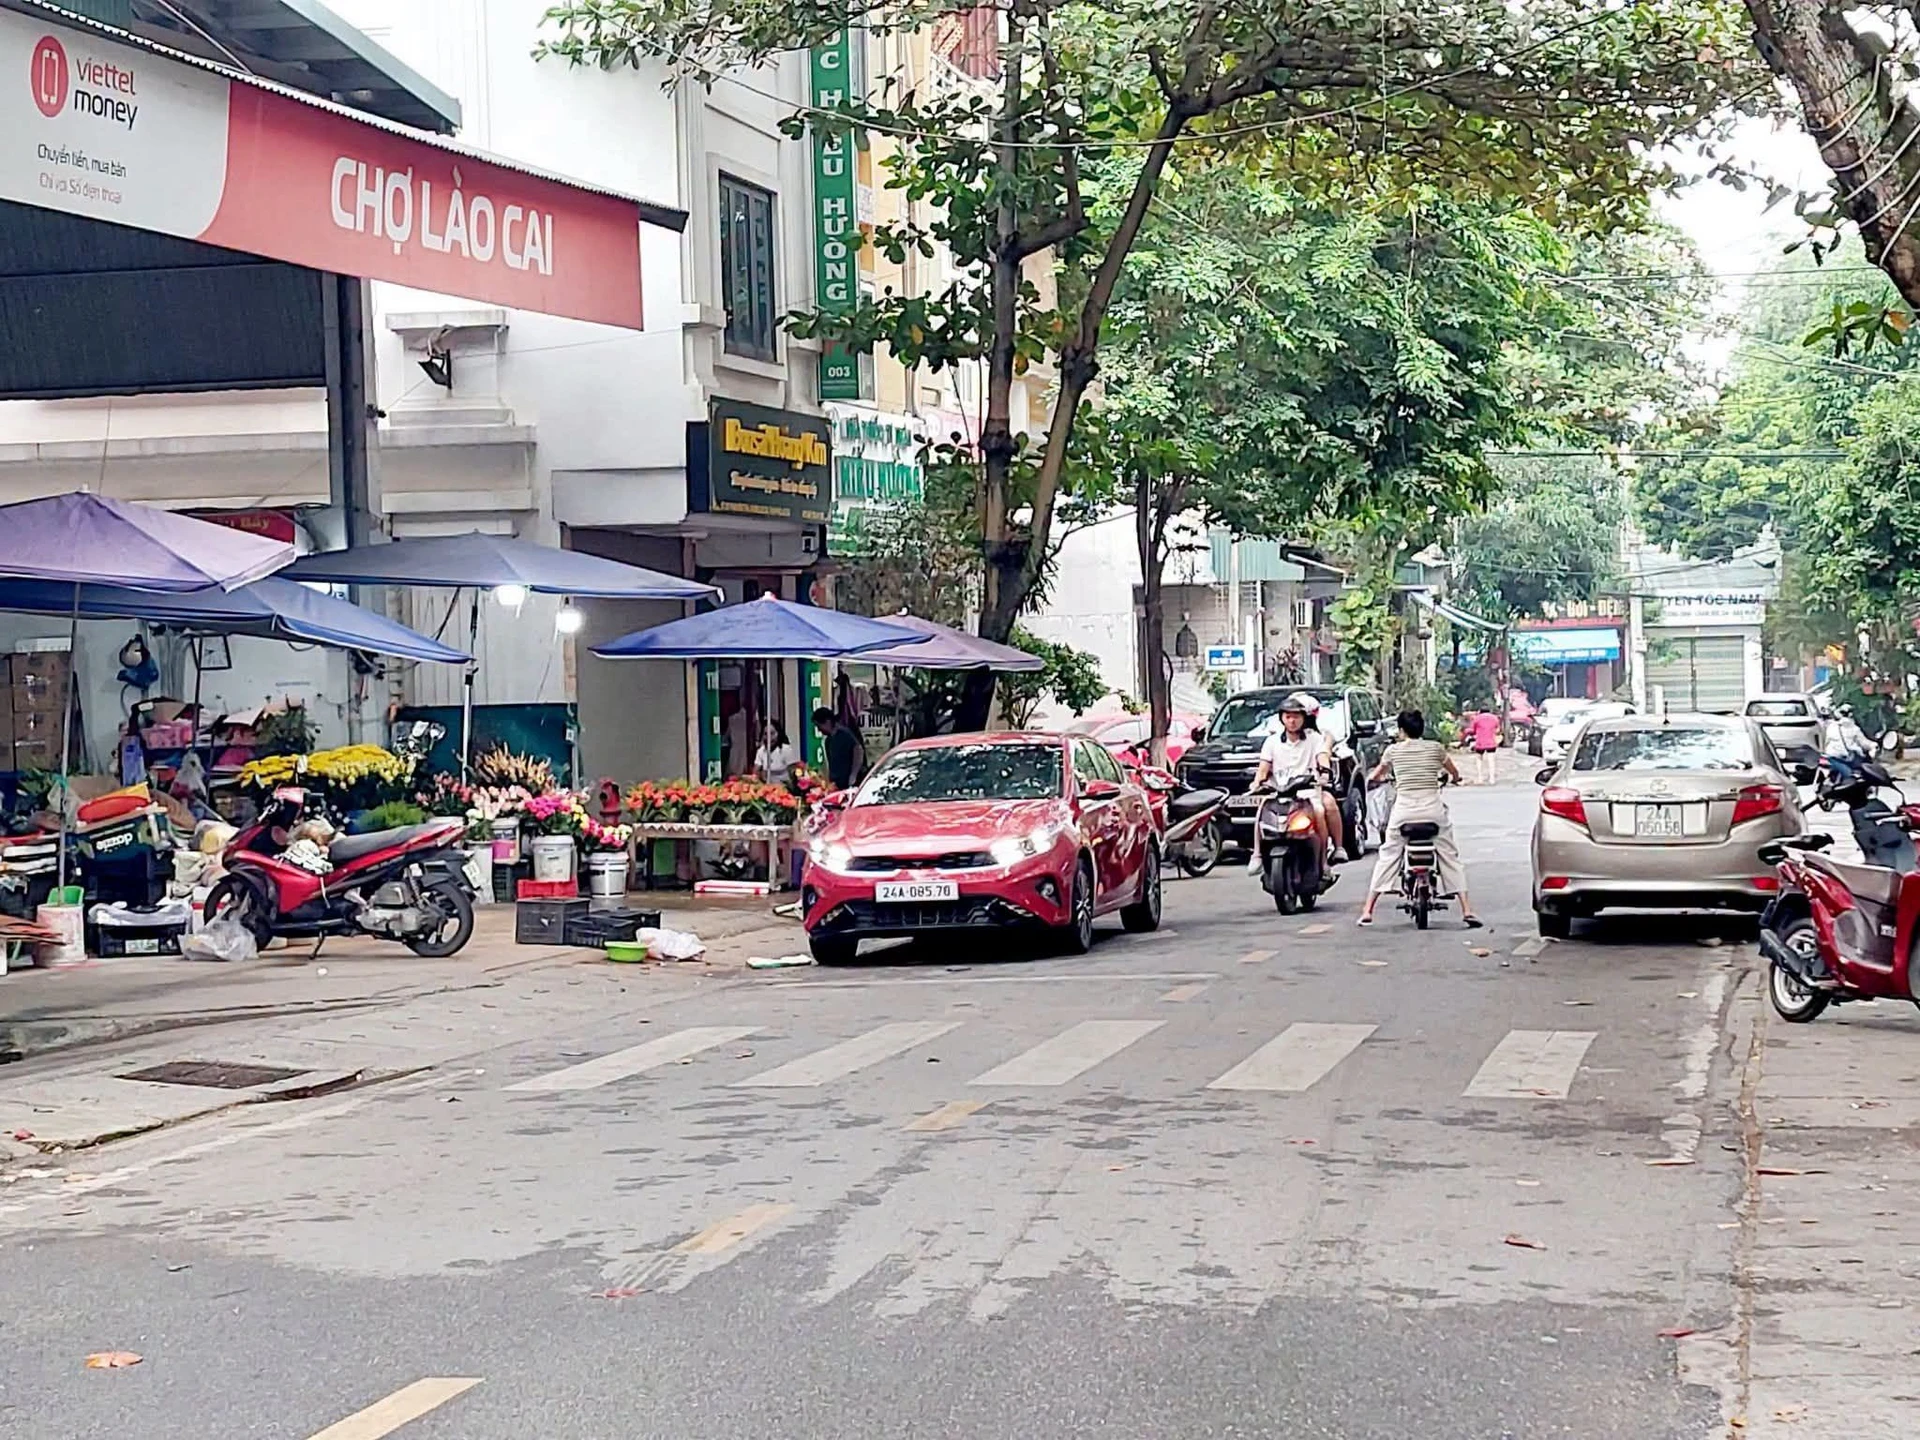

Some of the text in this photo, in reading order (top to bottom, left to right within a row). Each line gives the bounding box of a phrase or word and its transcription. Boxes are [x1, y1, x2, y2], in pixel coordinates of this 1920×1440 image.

[75, 57, 136, 96] viettel
[74, 89, 138, 131] money
[91, 158, 109, 175] mua
[331, 156, 553, 276] CHỢ LÀO CAI
[827, 365, 851, 378] 003
